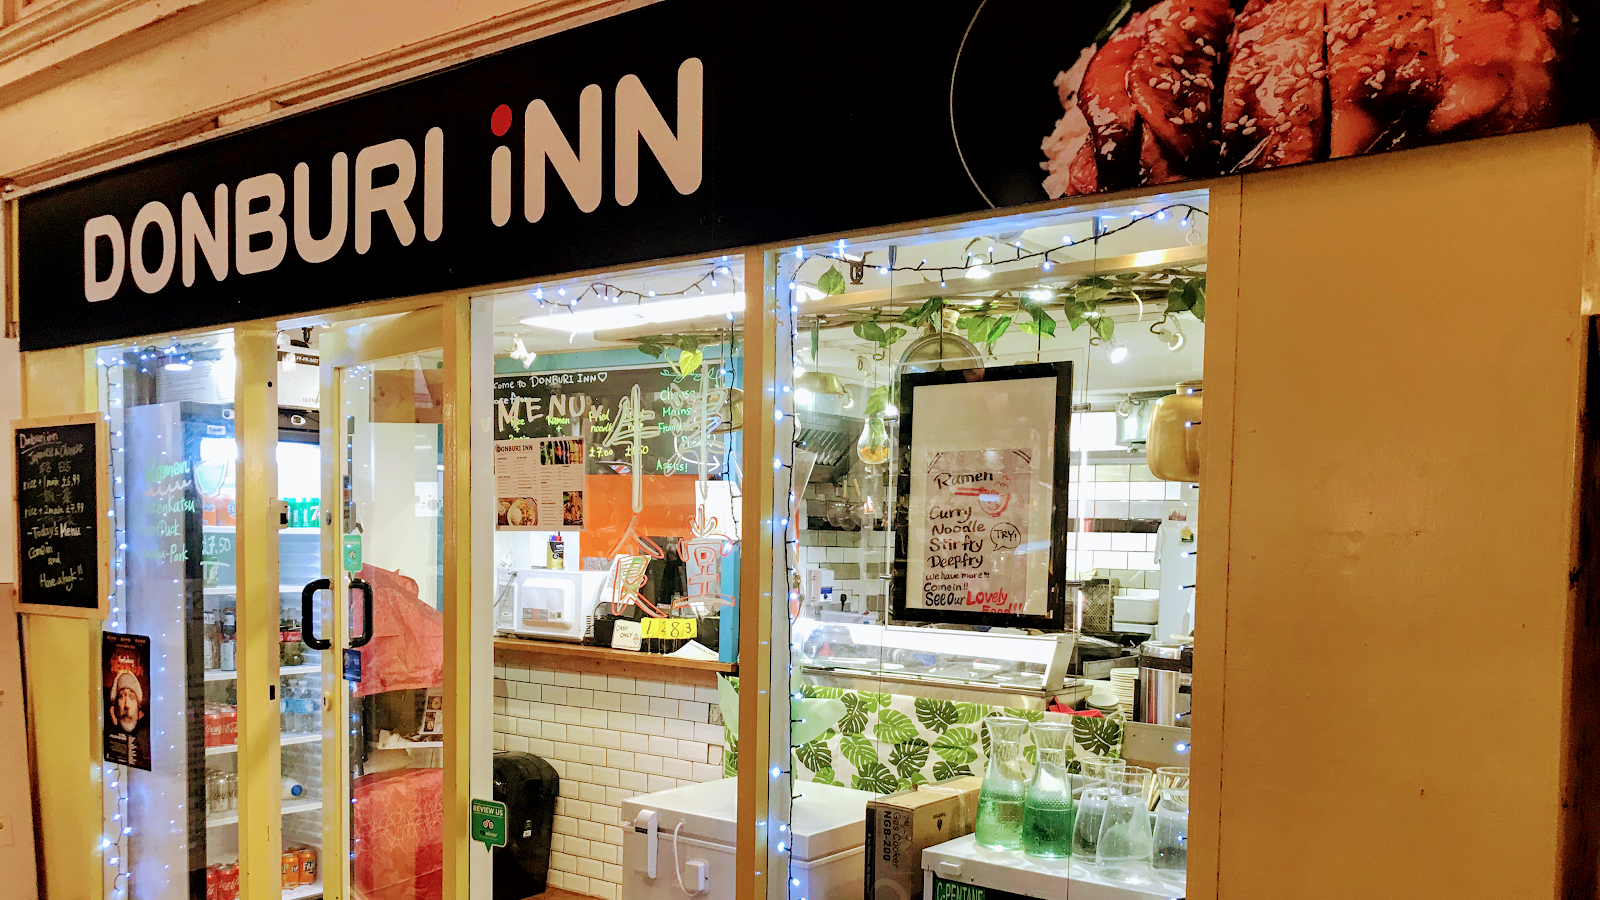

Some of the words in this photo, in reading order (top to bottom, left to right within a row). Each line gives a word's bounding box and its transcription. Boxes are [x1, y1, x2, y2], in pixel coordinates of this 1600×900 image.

[84, 126, 444, 303] DONBURI
[490, 57, 703, 228] iNN
[517, 380, 526, 388] to
[529, 374, 574, 388] DONBURI
[577, 373, 597, 383] INN
[498, 393, 586, 433] MENU
[497, 445, 522, 453] DONBURI
[933, 471, 994, 489] Ramen
[929, 506, 972, 523] Curry
[932, 520, 986, 536] Noodle
[993, 529, 1018, 542] TRY!
[925, 591, 946, 606] See
[947, 592, 965, 606] Our
[966, 587, 1008, 606] Lovely
[473, 804, 495, 815] REVIEW
[495, 808, 503, 817] US
[892, 812, 902, 832] Gas
[883, 810, 892, 862] NGB-200
[892, 833, 901, 869] Cooker
